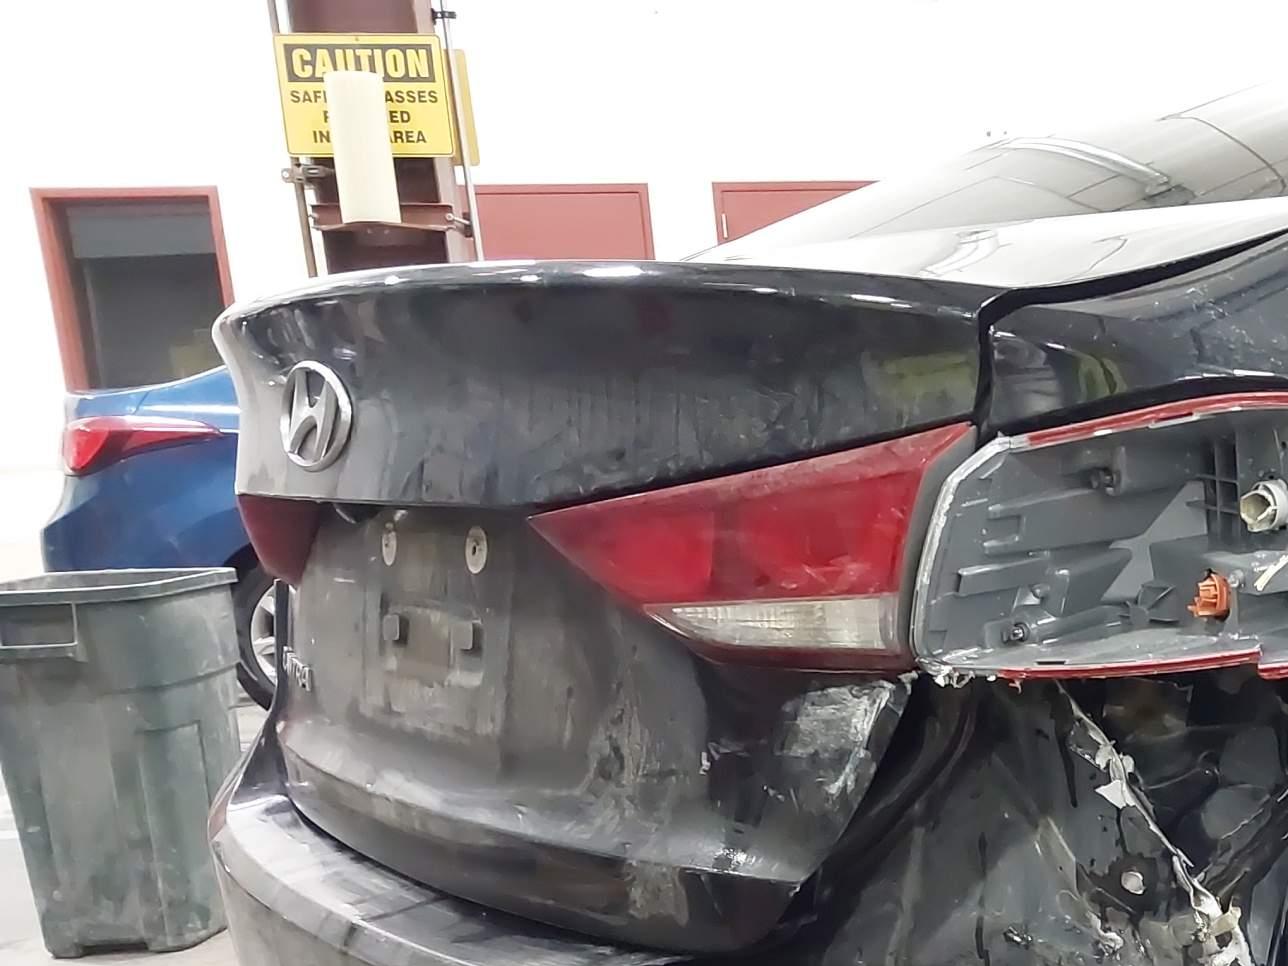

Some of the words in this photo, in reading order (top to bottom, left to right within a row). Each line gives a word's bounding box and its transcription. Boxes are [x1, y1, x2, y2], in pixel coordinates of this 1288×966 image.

[291, 48, 430, 79] CAUTION
[290, 90, 328, 103] SAF
[385, 90, 438, 103] ASSES
